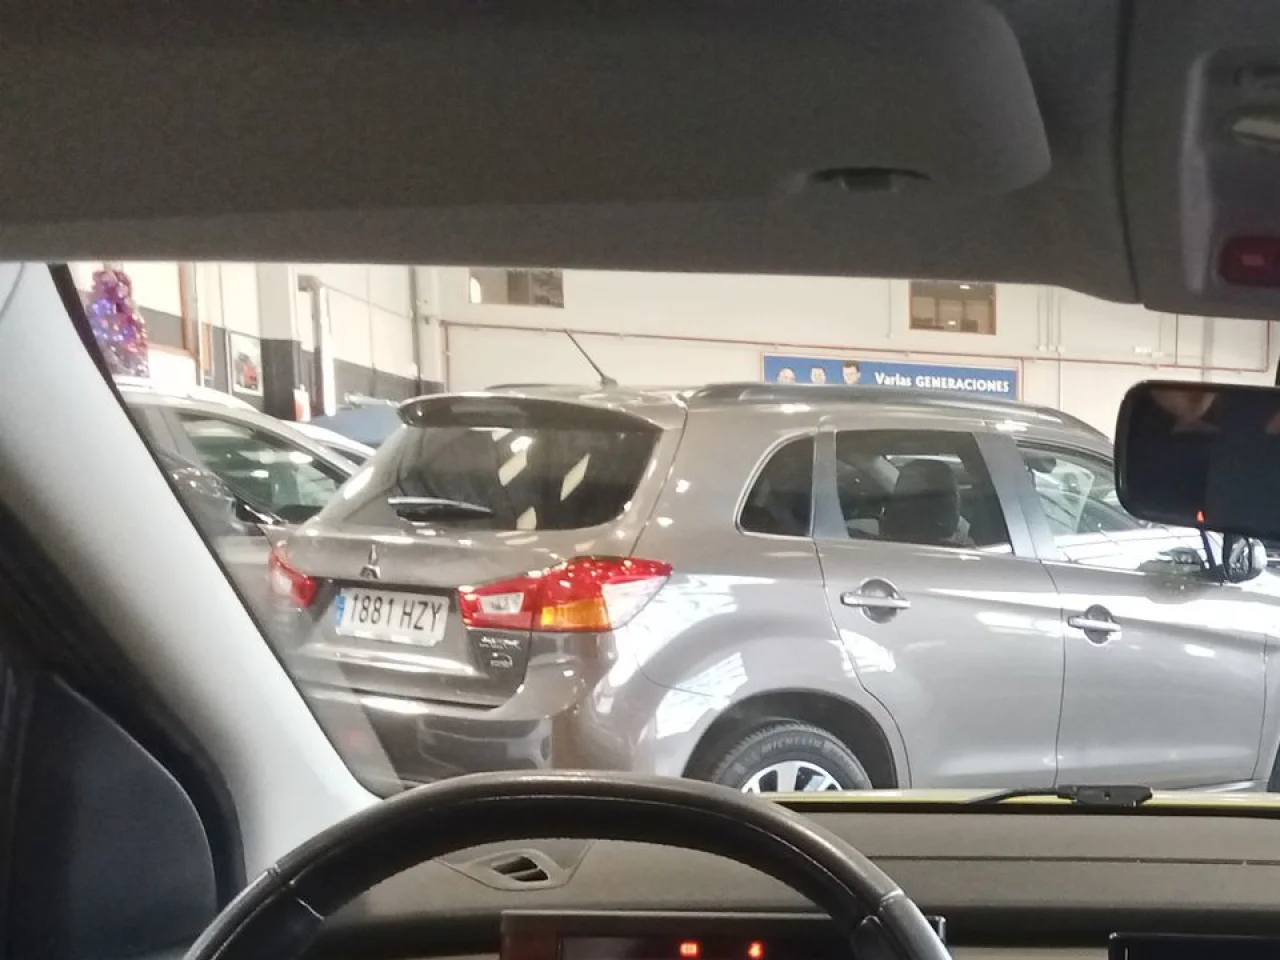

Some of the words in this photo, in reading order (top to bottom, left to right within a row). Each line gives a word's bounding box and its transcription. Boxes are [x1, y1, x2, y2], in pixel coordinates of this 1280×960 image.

[874, 371, 912, 387] Varias
[915, 376, 1010, 393] GENERACIONES
[351, 594, 395, 626] 1881
[401, 599, 443, 632] HZY
